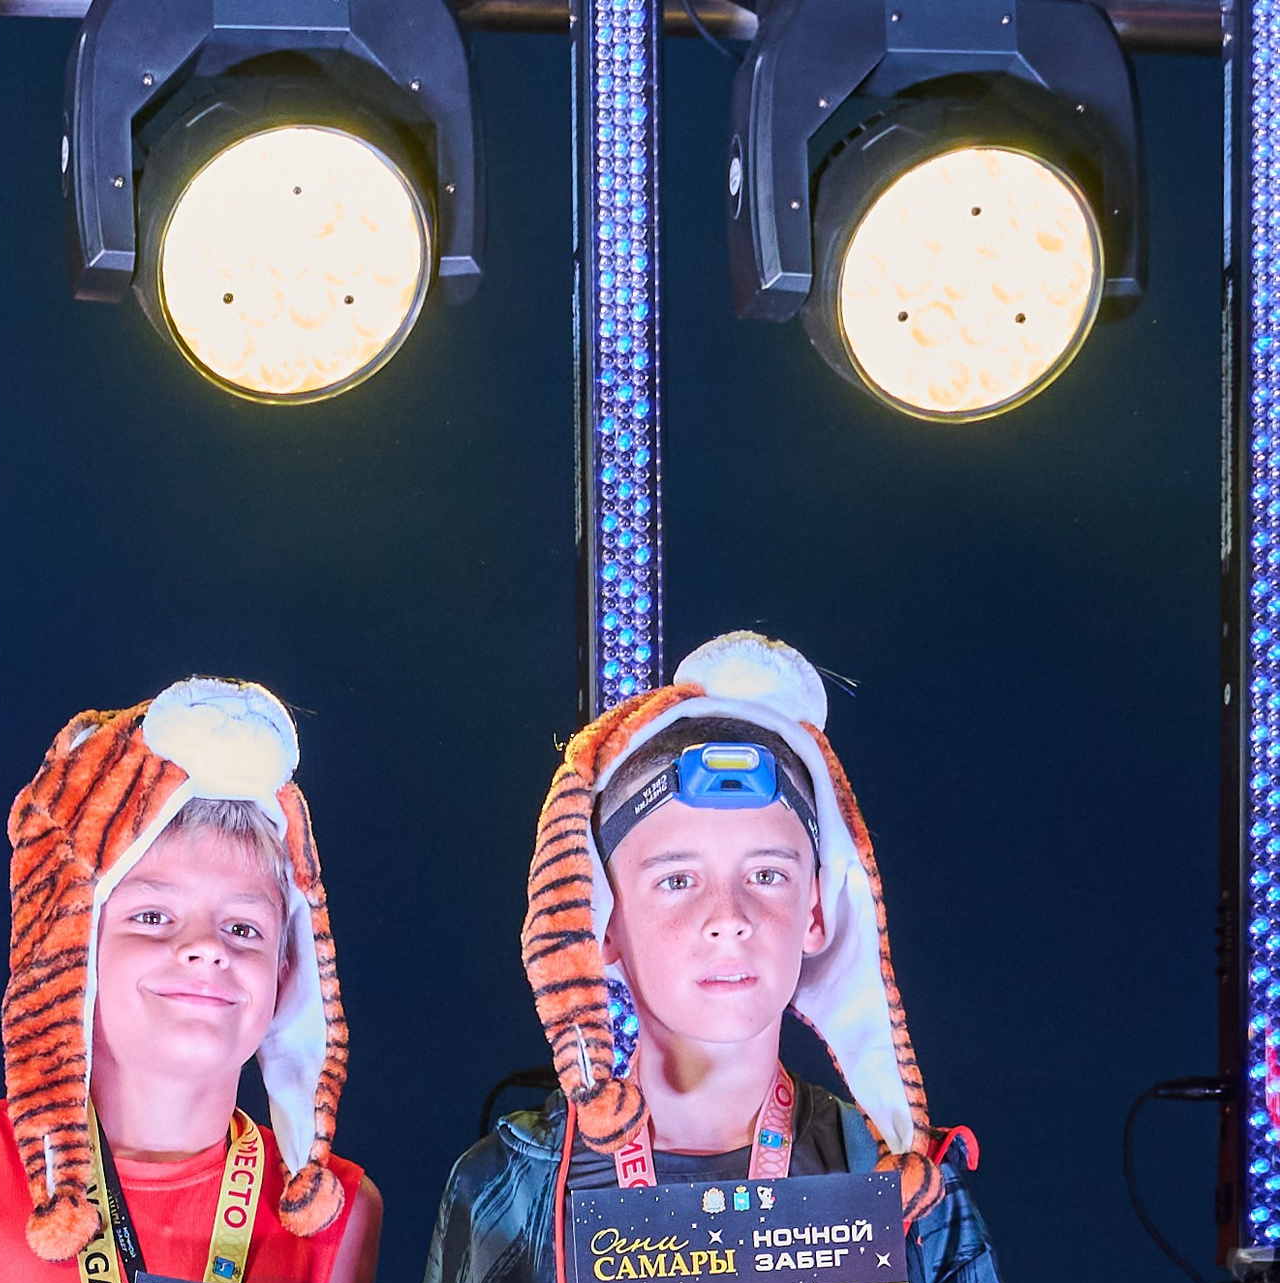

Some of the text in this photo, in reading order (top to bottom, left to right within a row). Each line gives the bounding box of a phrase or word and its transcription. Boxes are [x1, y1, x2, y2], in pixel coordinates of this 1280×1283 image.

[224, 1138, 258, 1229] МЕСТО
[590, 1228, 690, 1256] Огни
[753, 1219, 873, 1249] НОЧНОЙ
[593, 1249, 736, 1282] САМАРЫ
[754, 1248, 849, 1273] ЗАБЕГ
